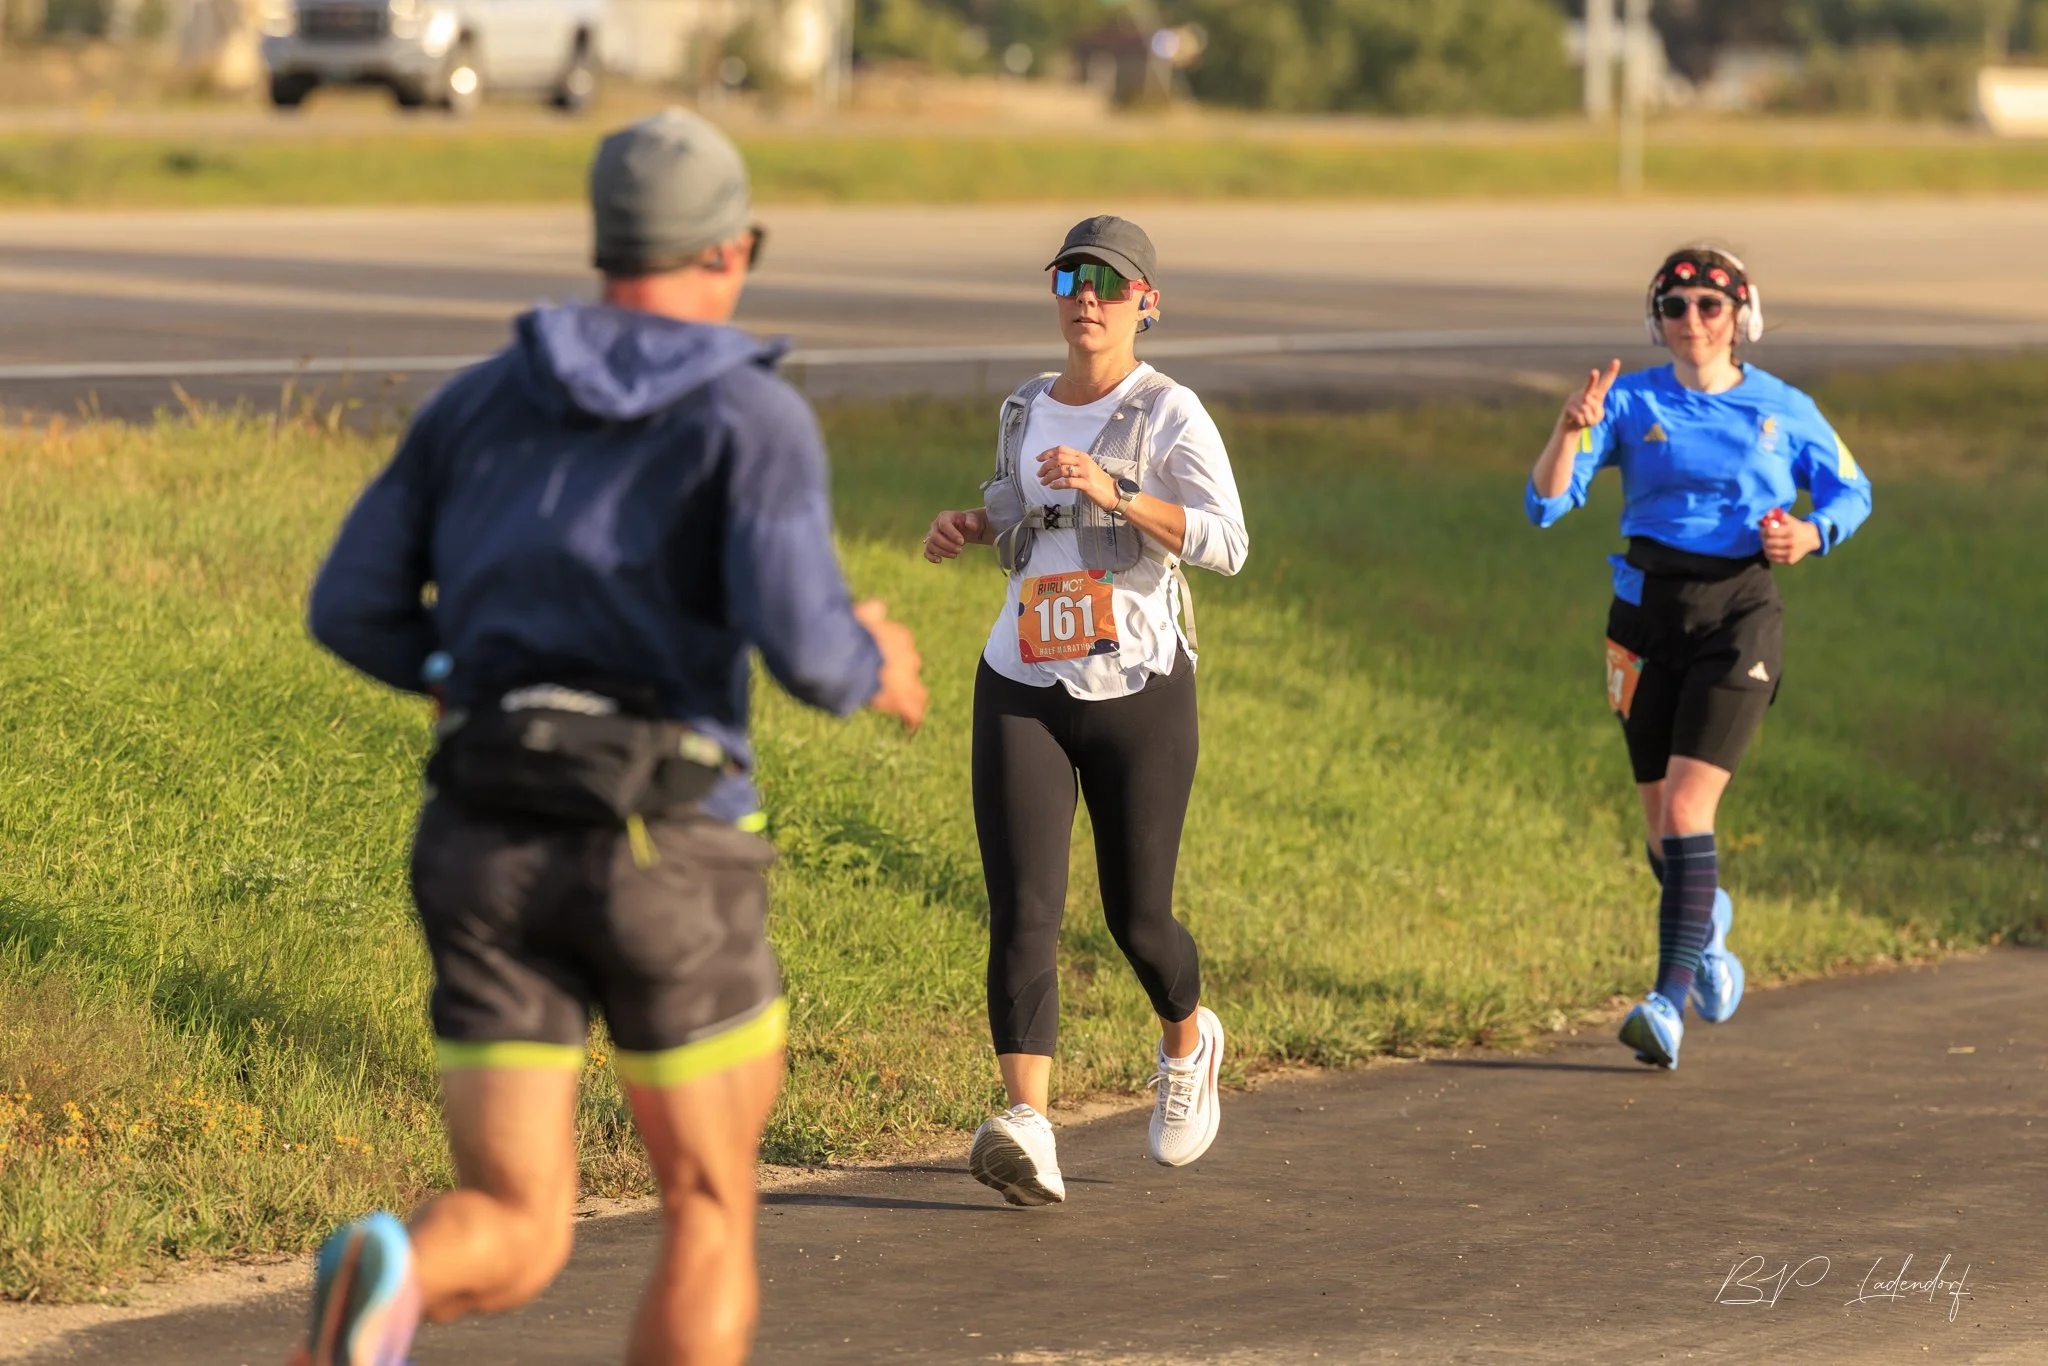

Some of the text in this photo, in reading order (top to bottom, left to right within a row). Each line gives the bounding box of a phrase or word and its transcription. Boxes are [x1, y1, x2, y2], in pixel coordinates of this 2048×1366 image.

[1034, 594, 1096, 642] 161
[1040, 642, 1096, 655] HALF MARATHON
